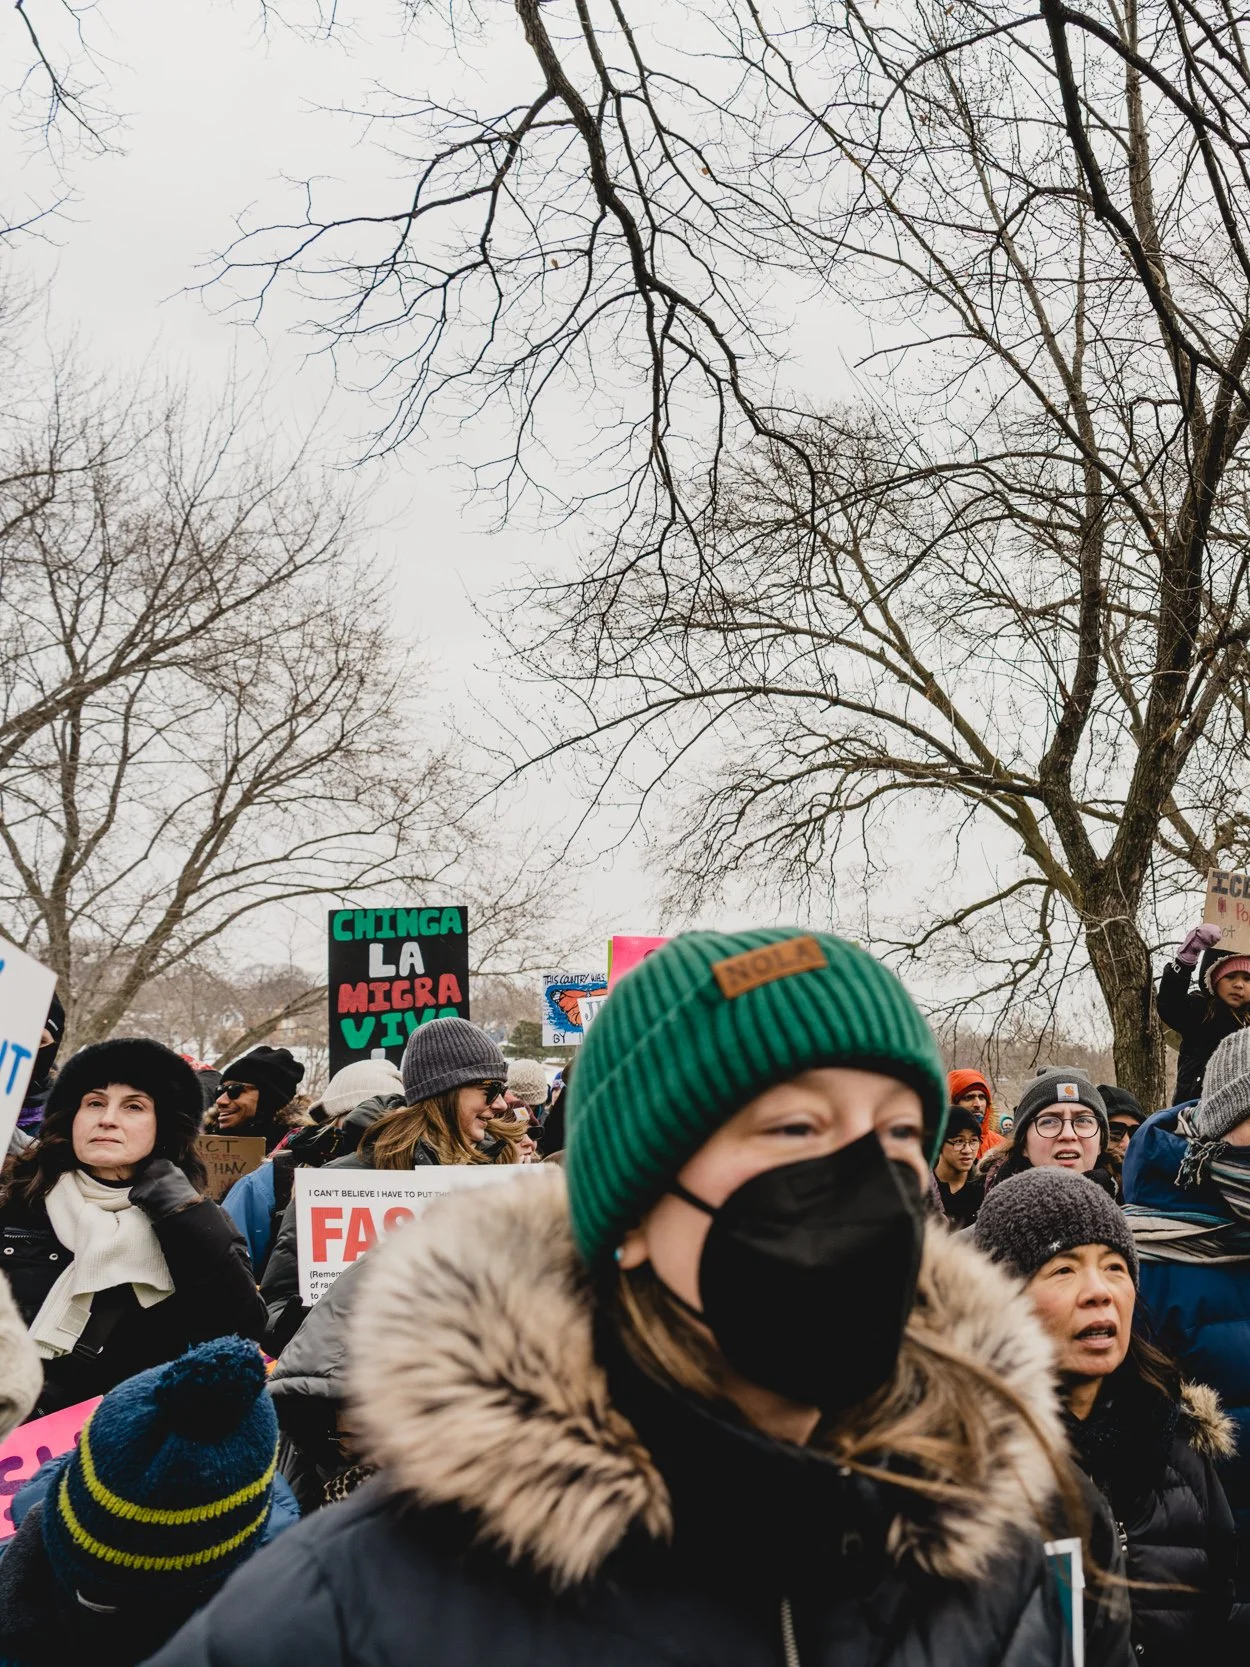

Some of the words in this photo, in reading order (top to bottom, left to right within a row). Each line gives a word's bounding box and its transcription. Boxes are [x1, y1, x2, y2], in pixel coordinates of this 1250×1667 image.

[333, 908, 463, 941] CHINGA
[1219, 925, 1236, 938] ot
[369, 941, 425, 978] LA
[543, 974, 559, 985] THIS
[560, 973, 589, 985] COUNTRY
[591, 972, 605, 982] WAS
[338, 973, 462, 1014] MIGRA
[314, 1189, 339, 1197] CAN'T
[341, 1190, 375, 1198] BELIEVE
[382, 1190, 402, 1198] HAVE
[310, 1281, 319, 1289] of
[310, 1292, 319, 1300] to
